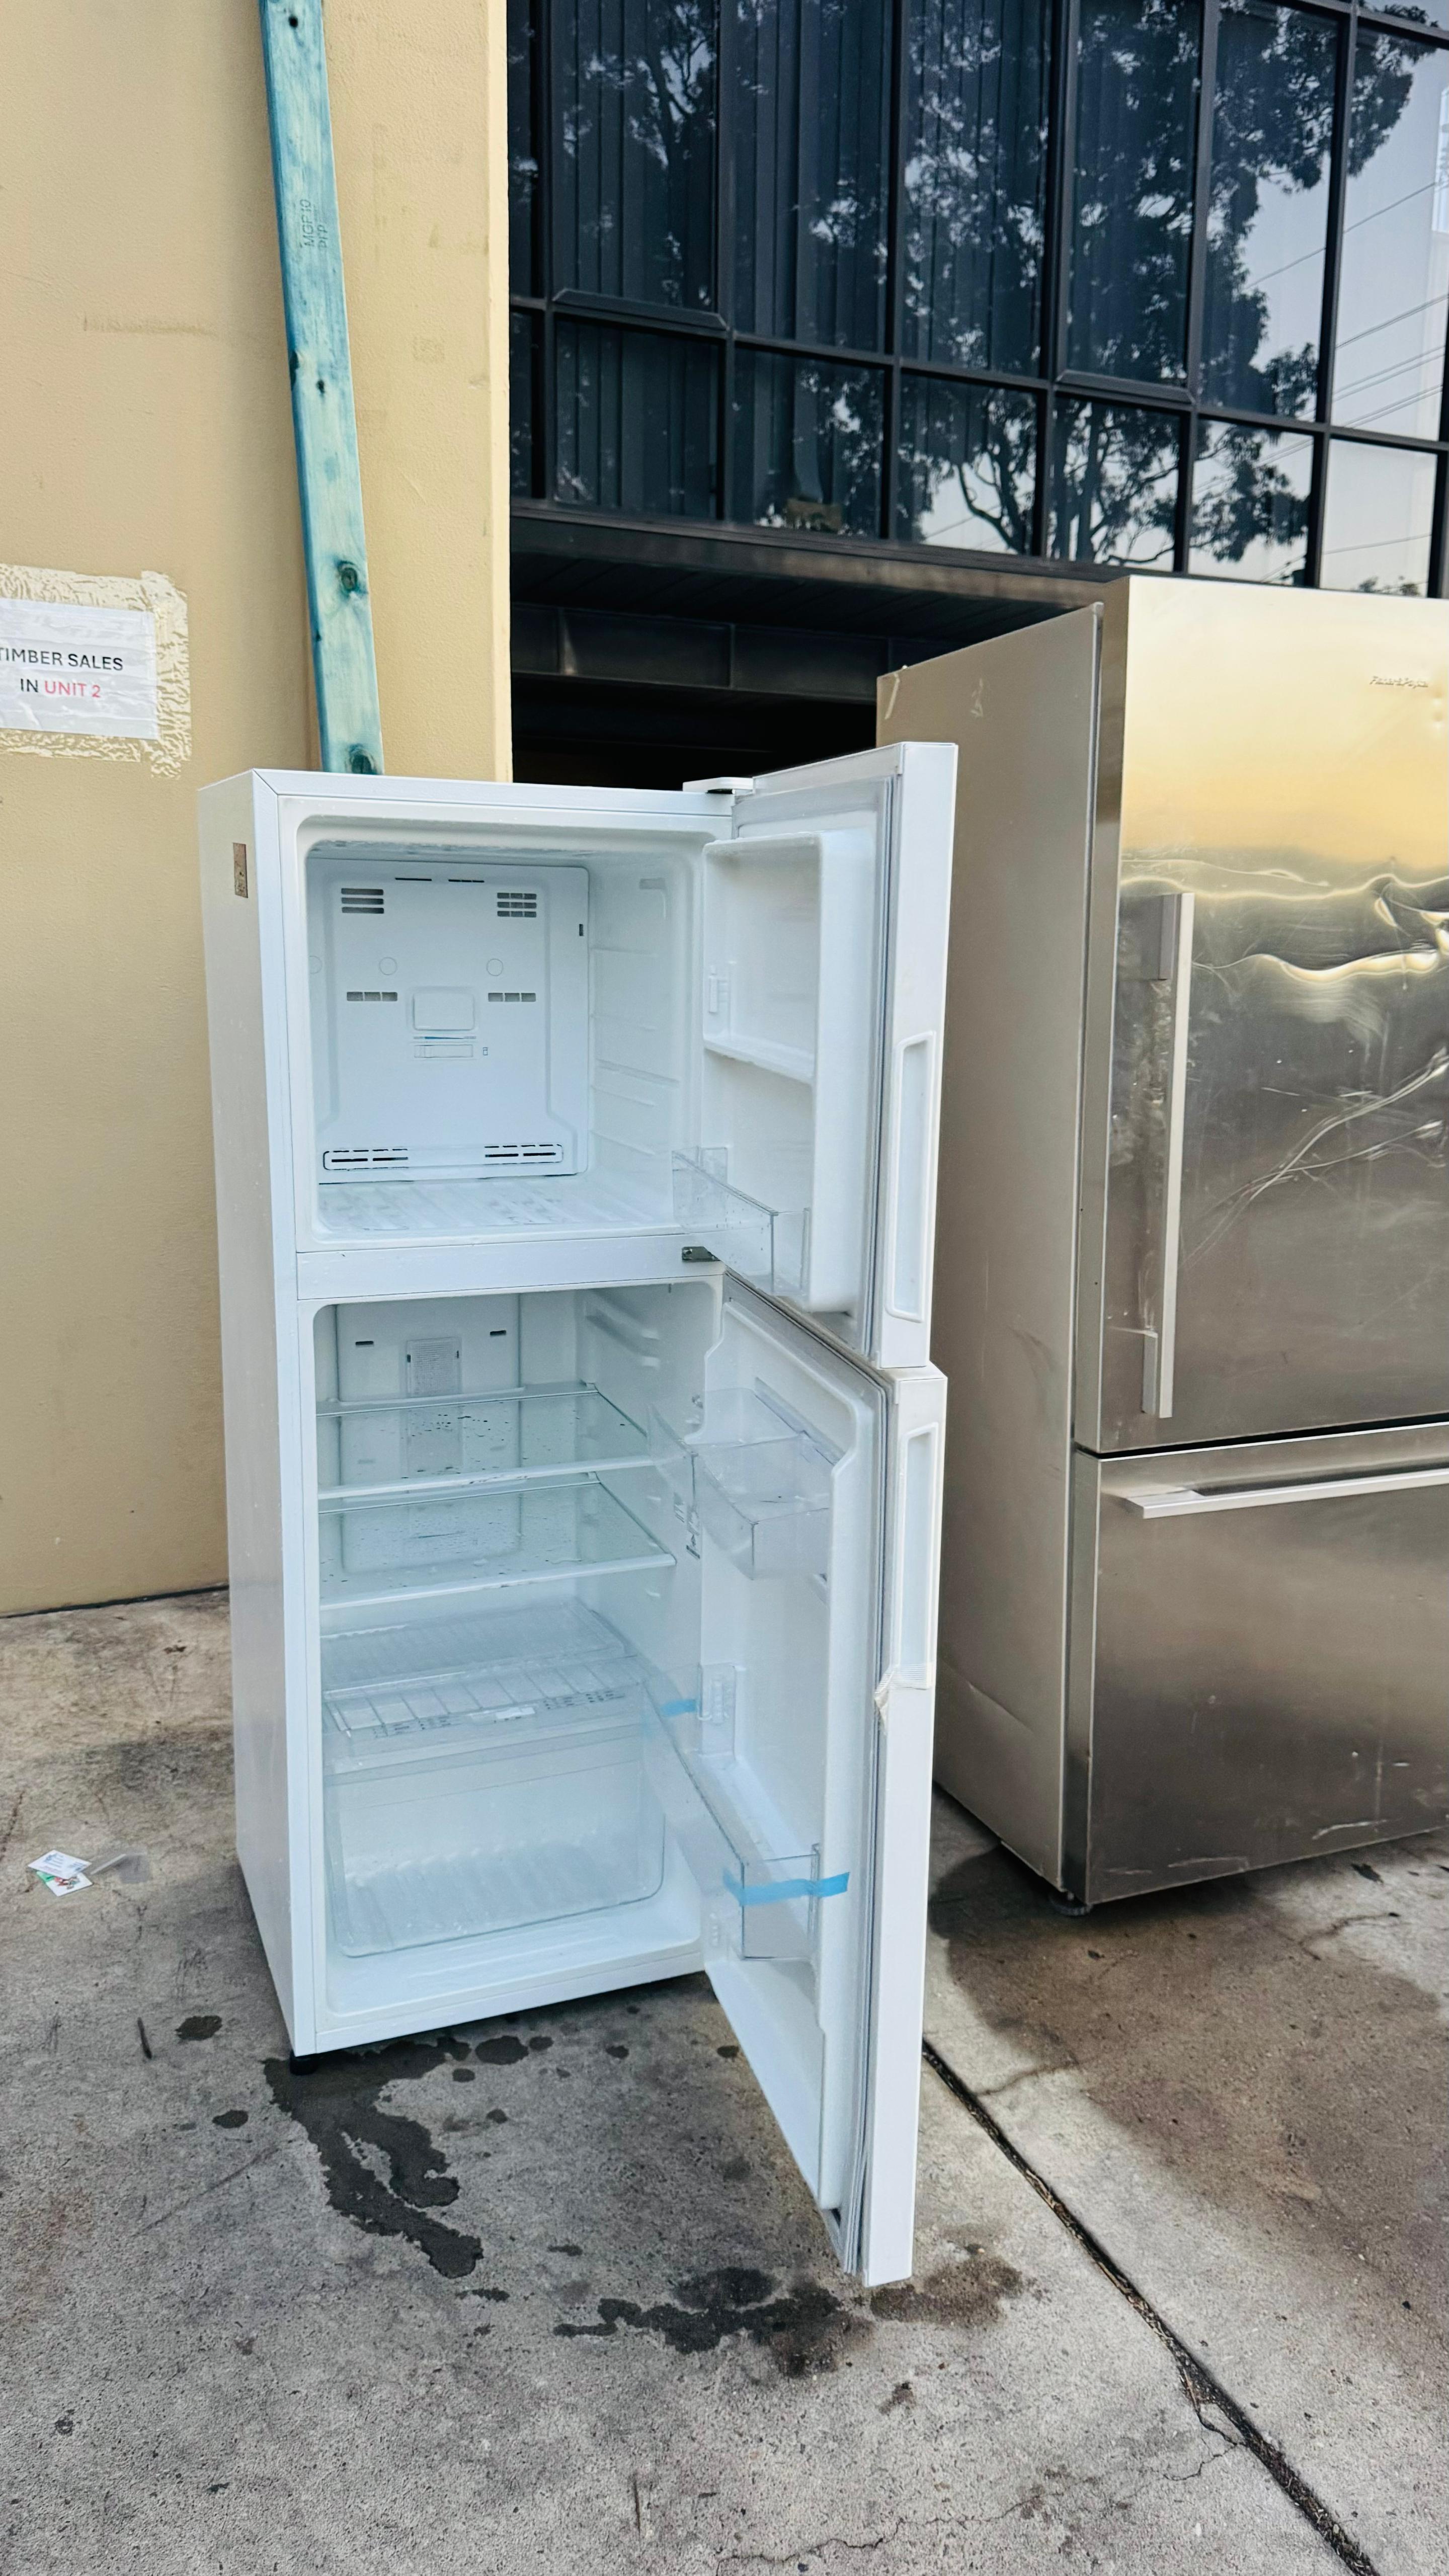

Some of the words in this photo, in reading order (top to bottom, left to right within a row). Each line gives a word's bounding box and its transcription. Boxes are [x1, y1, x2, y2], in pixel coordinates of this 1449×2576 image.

[0, 648, 62, 666] TIMBER
[68, 654, 123, 671] SALES
[21, 678, 38, 692] IN
[45, 681, 87, 696] UNIT
[92, 685, 101, 698] 2
